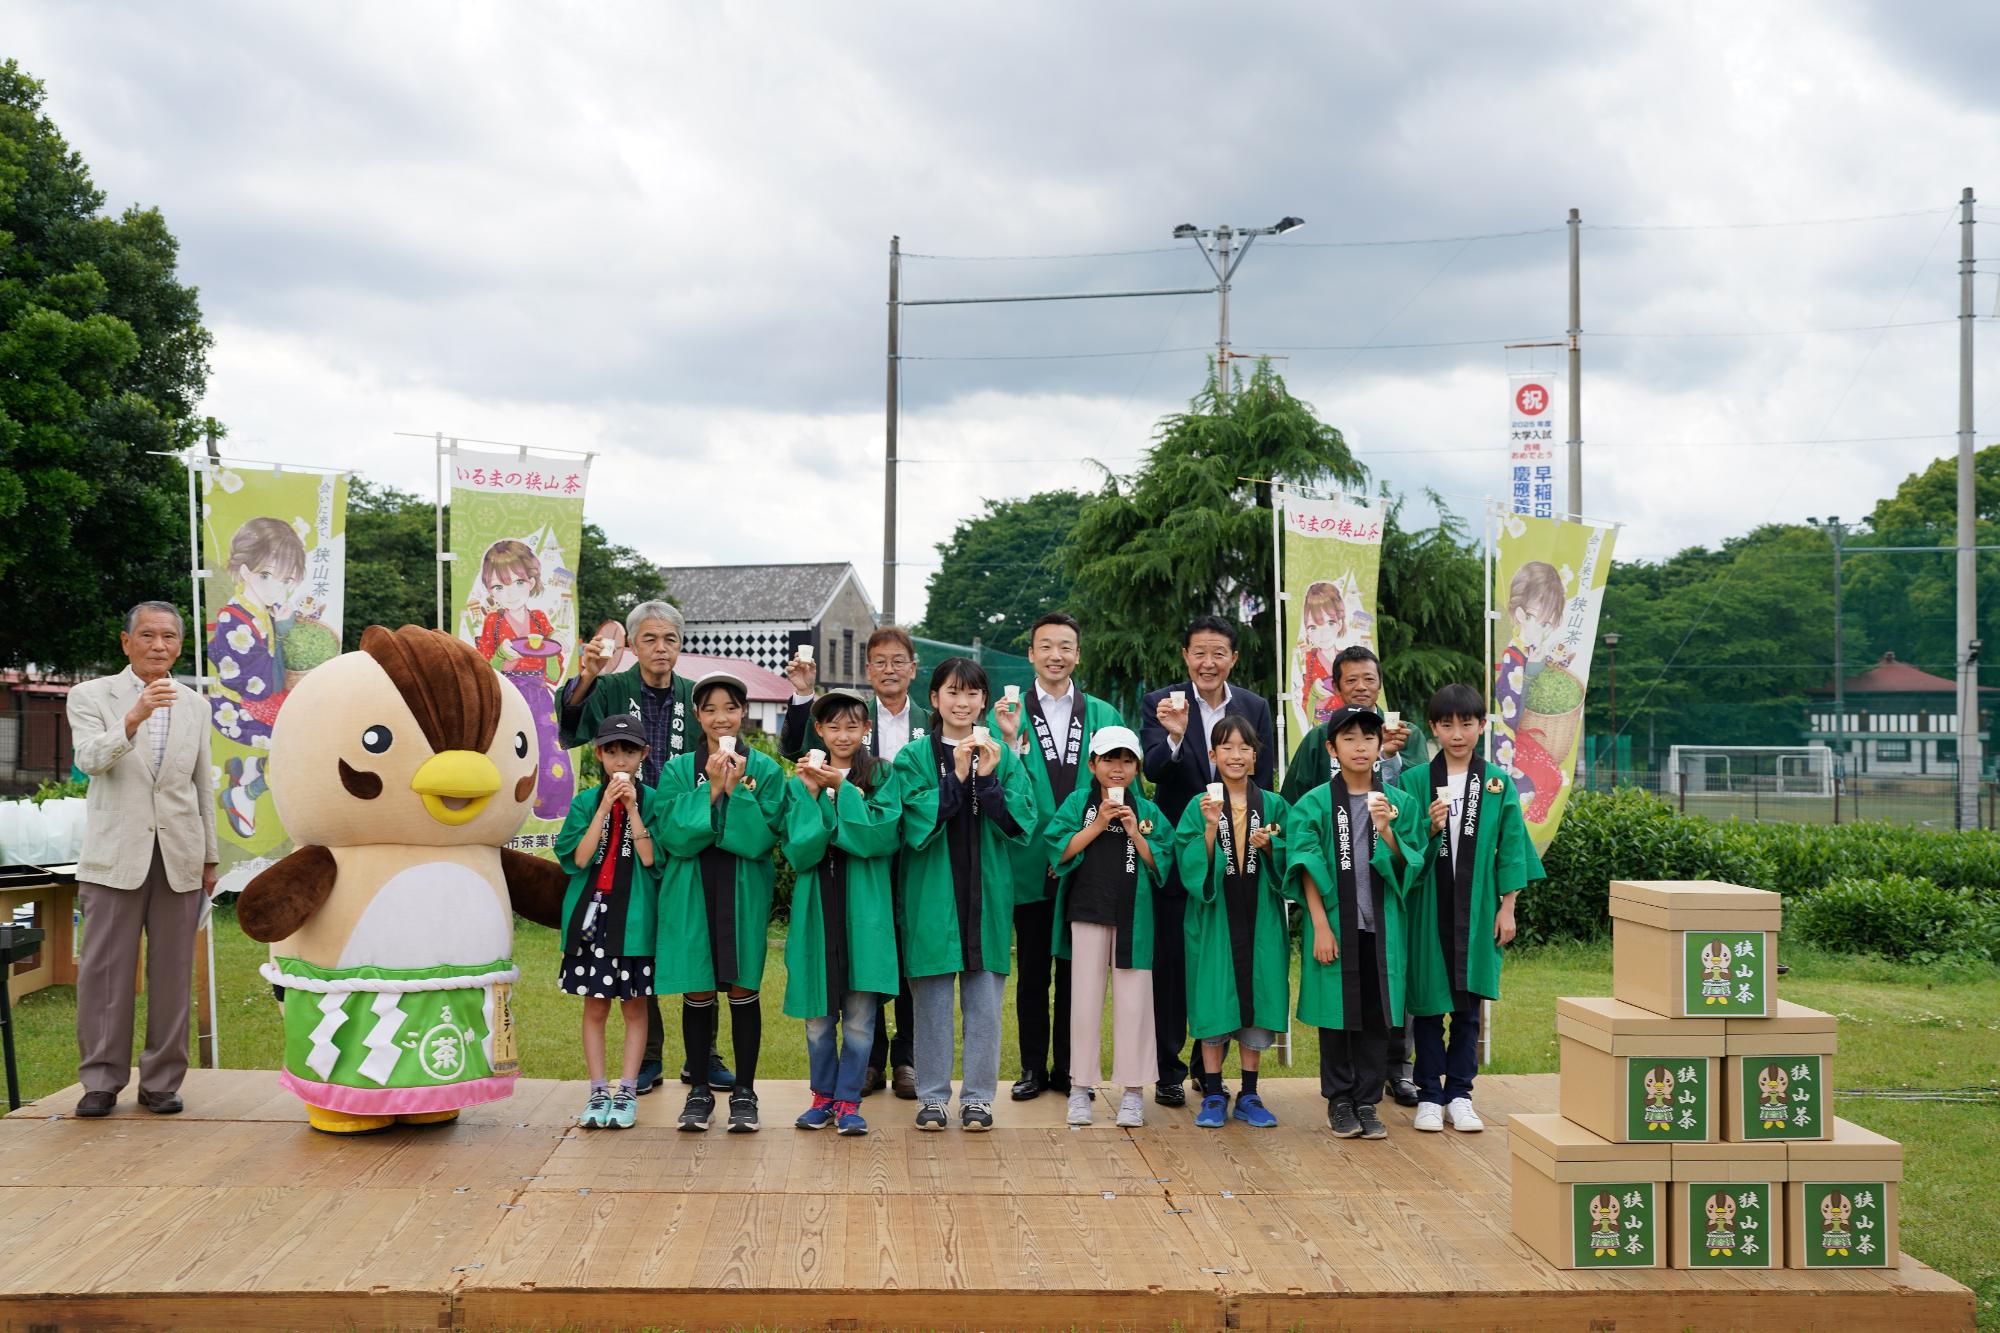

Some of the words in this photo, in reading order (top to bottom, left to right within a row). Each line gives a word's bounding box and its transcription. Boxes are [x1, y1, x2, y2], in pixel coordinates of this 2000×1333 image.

[1522, 390, 1543, 410] 祝
[1511, 451, 1552, 459] おめでとう
[1512, 430, 1552, 440] 大学入試
[456, 465, 582, 494] いるまの狭山茶
[1535, 466, 1551, 518] 早稲田
[1289, 511, 1380, 541] いるまの狭山茶
[312, 548, 331, 597] 狭山茶
[1561, 597, 1588, 645] 狭山茶
[1033, 714, 1058, 761] 入間市長
[1066, 716, 1082, 765] 入間市長
[1463, 773, 1481, 837] 入間市お茶大使
[1219, 811, 1236, 875] 入間市お茶大使
[1246, 809, 1260, 874] 入間市茶大使
[1337, 806, 1351, 870] 入間市お茶大使
[1734, 940, 1755, 1004] 狭山茶
[431, 1036, 459, 1070] 茶
[1677, 1065, 1698, 1130] 狭山茶
[1791, 1063, 1812, 1127] 狭山茶
[1623, 1191, 1644, 1255] 狭山茶
[1739, 1191, 1760, 1255] 狭山茶
[1855, 1191, 1876, 1255] 狭山茶
